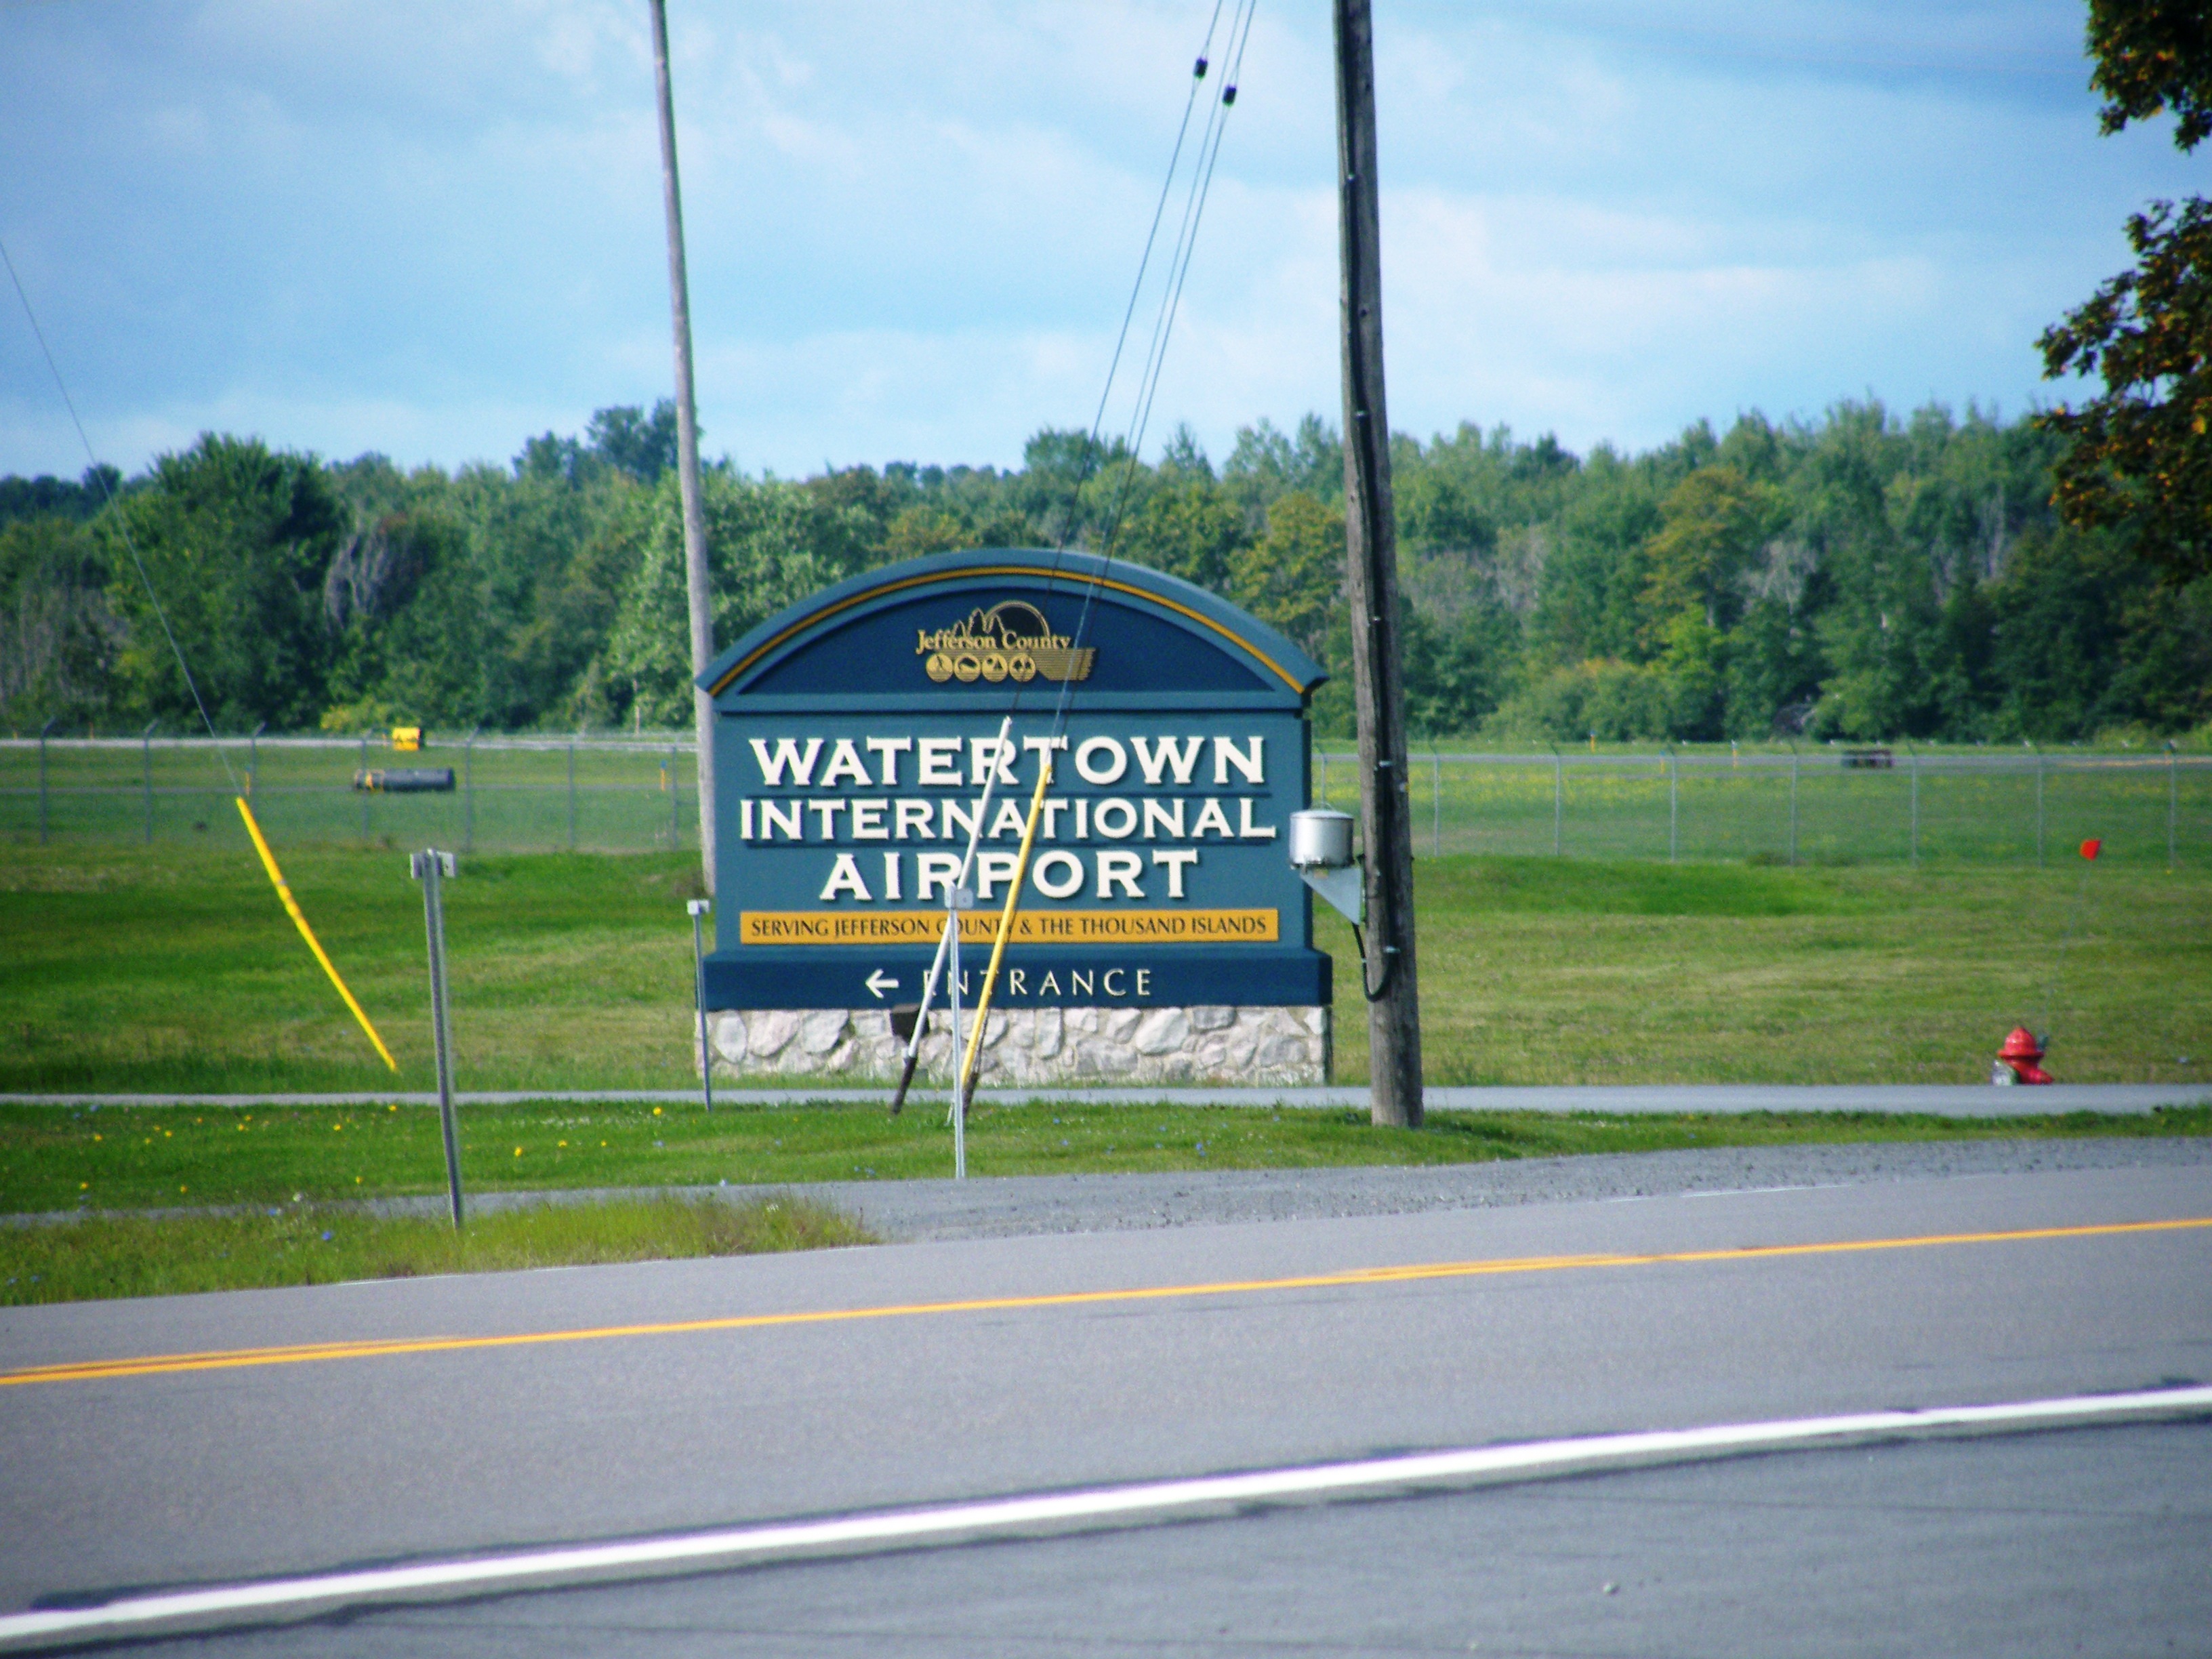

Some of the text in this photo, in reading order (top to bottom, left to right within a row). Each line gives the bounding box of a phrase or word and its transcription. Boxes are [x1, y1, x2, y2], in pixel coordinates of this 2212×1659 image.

[916, 630, 1071, 655] Jefferson County
[748, 735, 1265, 786] WATERTOWN
[740, 797, 1276, 840] INTERNATIONAL
[819, 848, 1198, 901] AIRPORT
[752, 916, 1267, 938] SERVING JEFFERSON COUNT & THE THOUSAND ISLANDS
